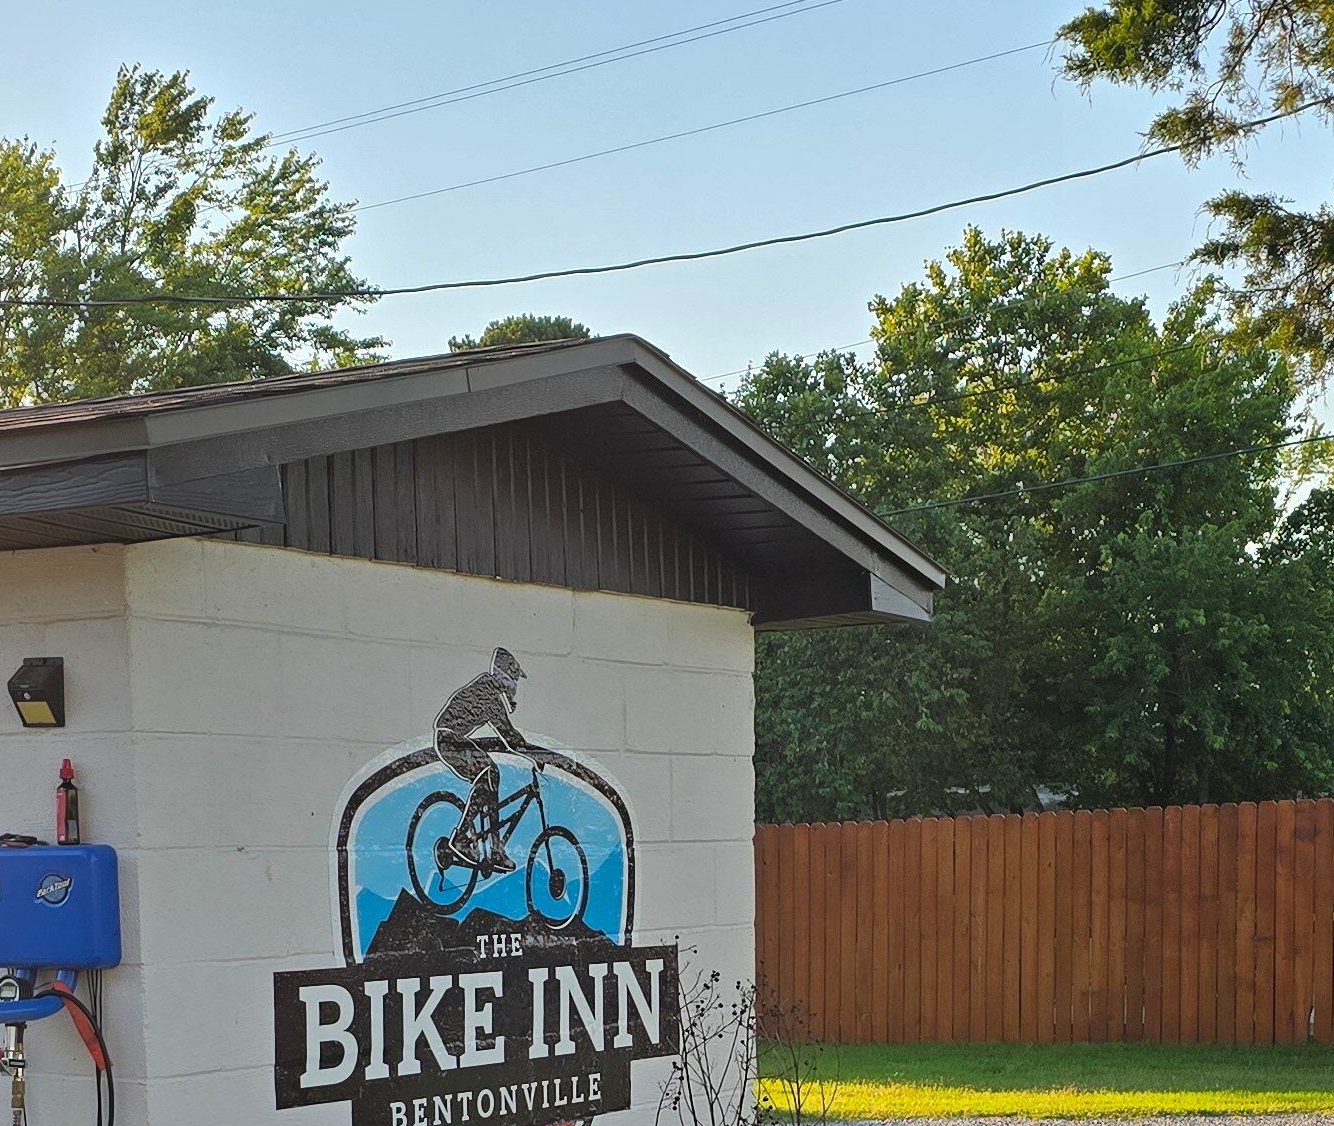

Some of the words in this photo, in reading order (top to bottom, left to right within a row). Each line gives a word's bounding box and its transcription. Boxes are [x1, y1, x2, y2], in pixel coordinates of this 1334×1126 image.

[477, 933, 523, 959] THE
[299, 971, 505, 1089] BIKE
[527, 958, 665, 1060] INN
